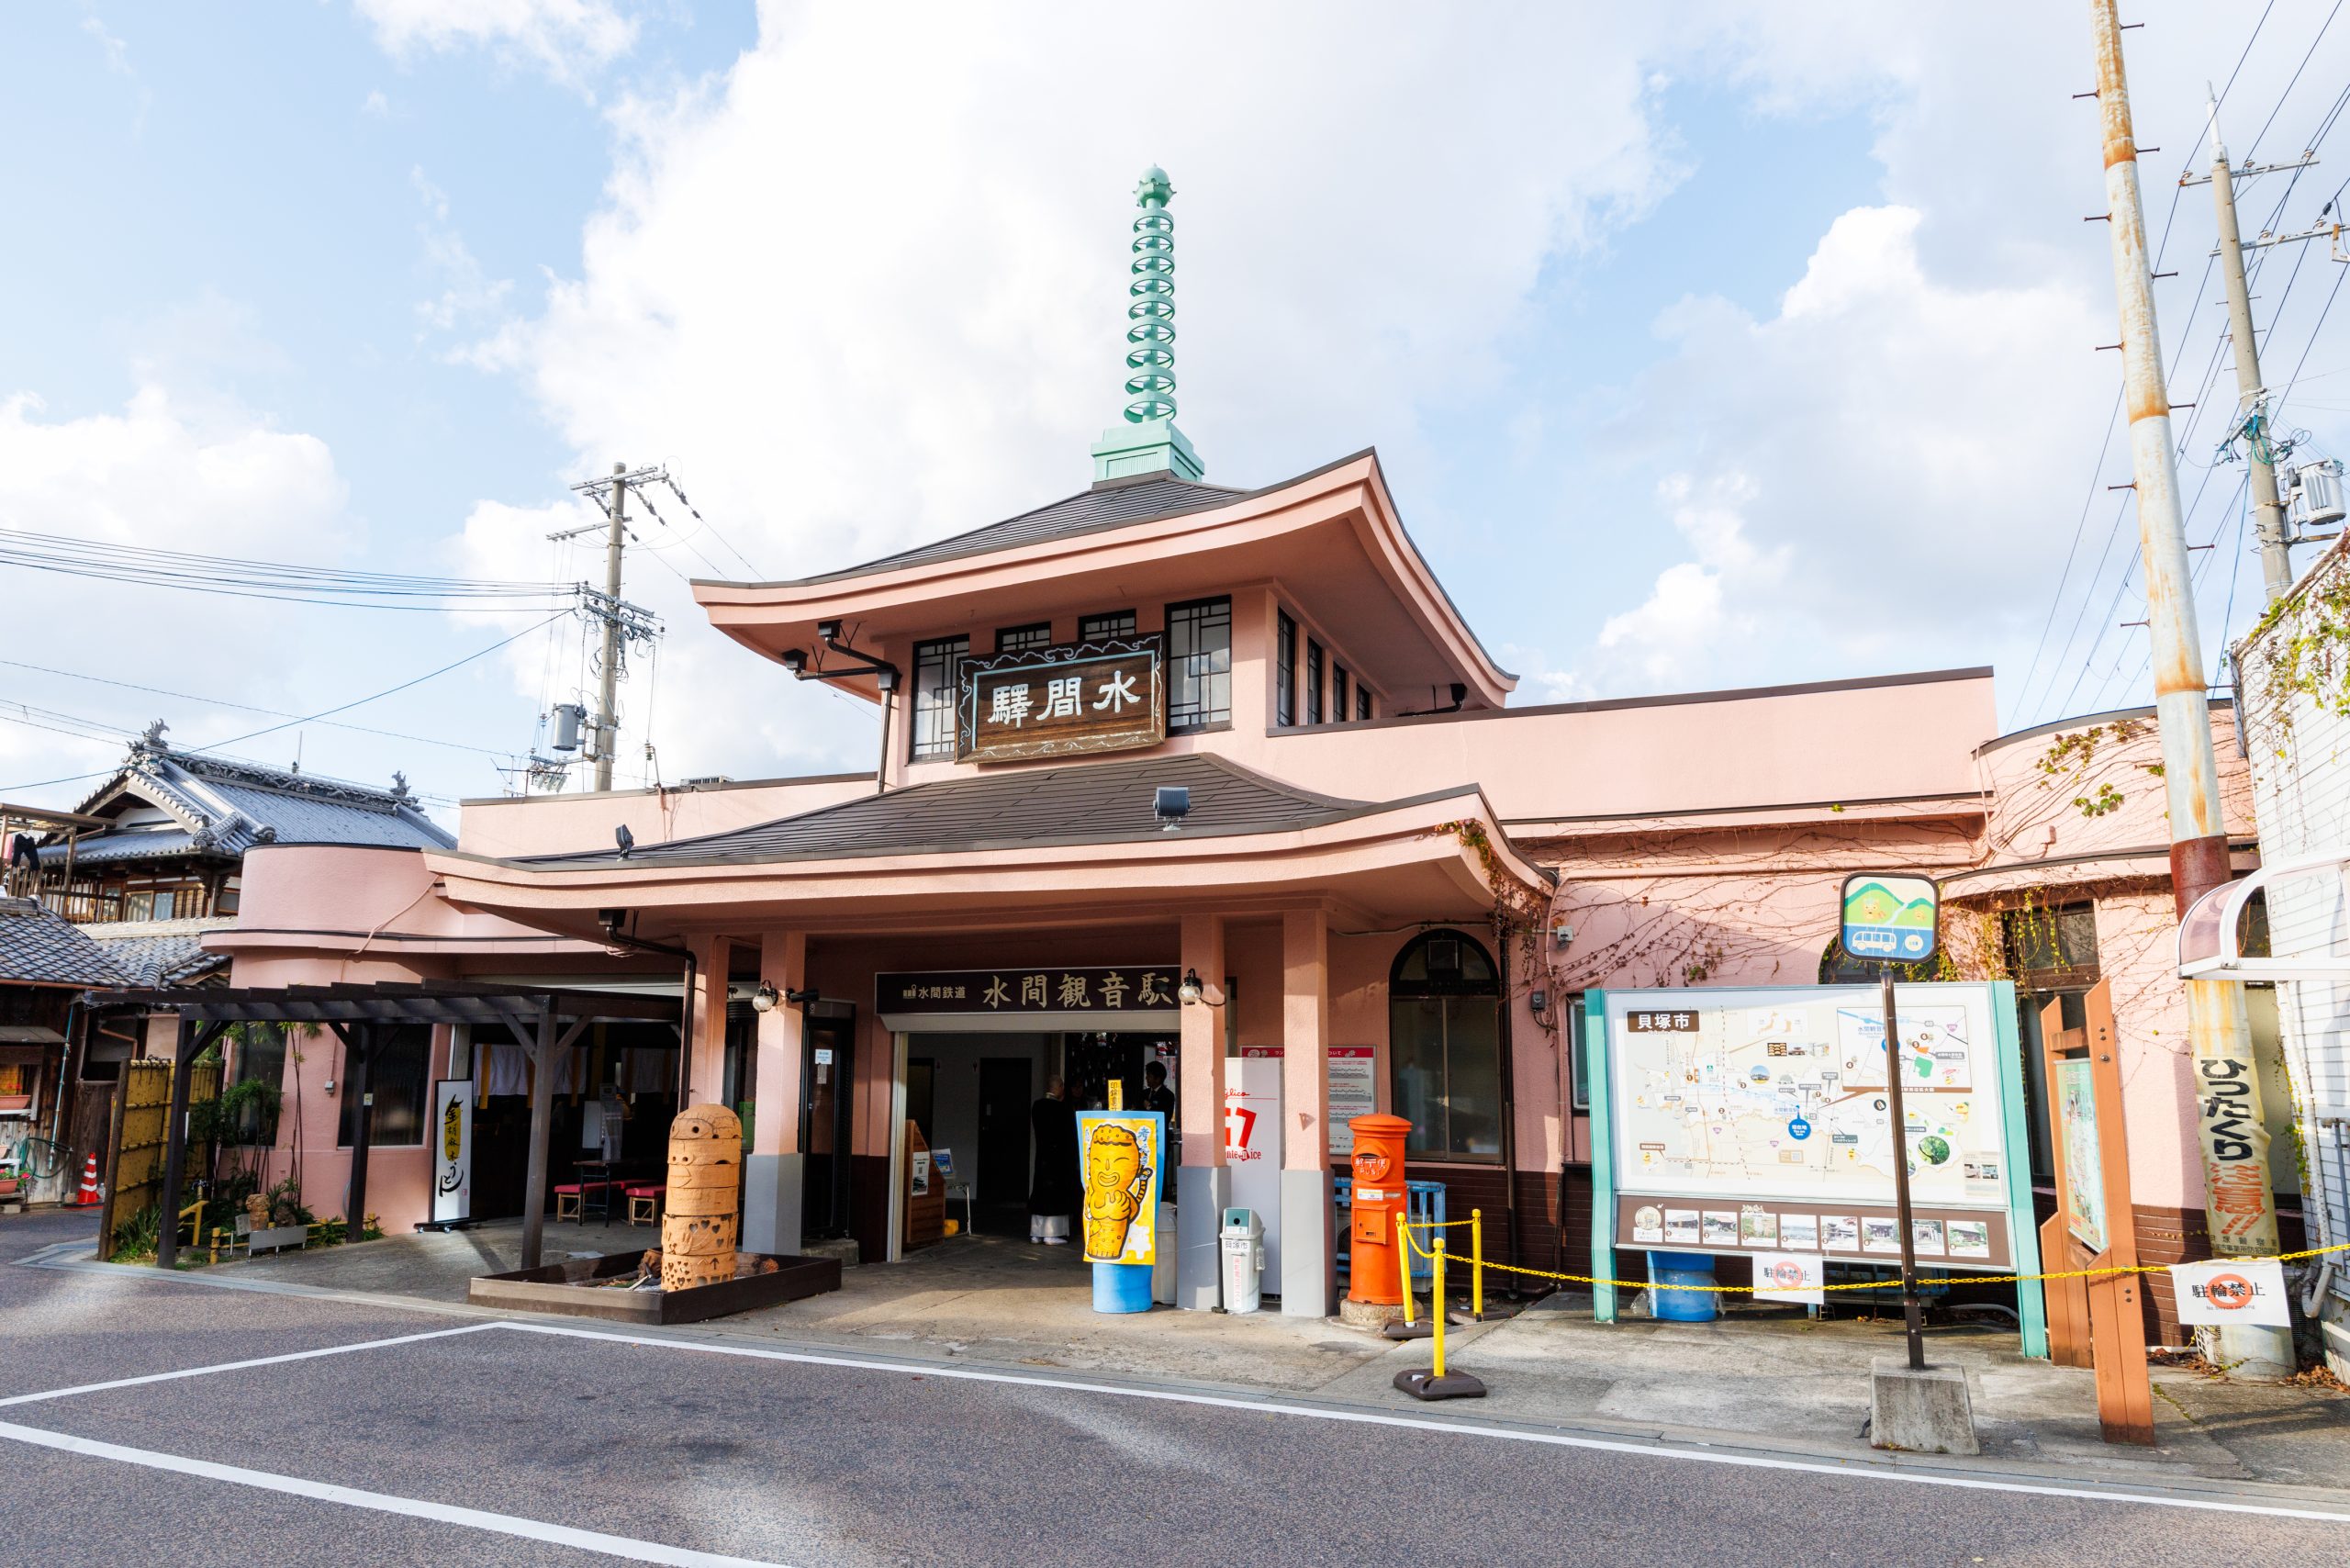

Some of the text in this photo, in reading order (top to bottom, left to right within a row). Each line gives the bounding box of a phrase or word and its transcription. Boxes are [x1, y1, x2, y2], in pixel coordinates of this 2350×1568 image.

[919, 970, 1173, 1009] 水間鉄道 水間観音駅
[1638, 1014, 1689, 1029] 貝塚市
[1225, 1240, 1248, 1249] 貝塚市
[1763, 1267, 1811, 1281] 駐輪禁止
[2191, 1282, 2266, 1298] 駐輪禁止
